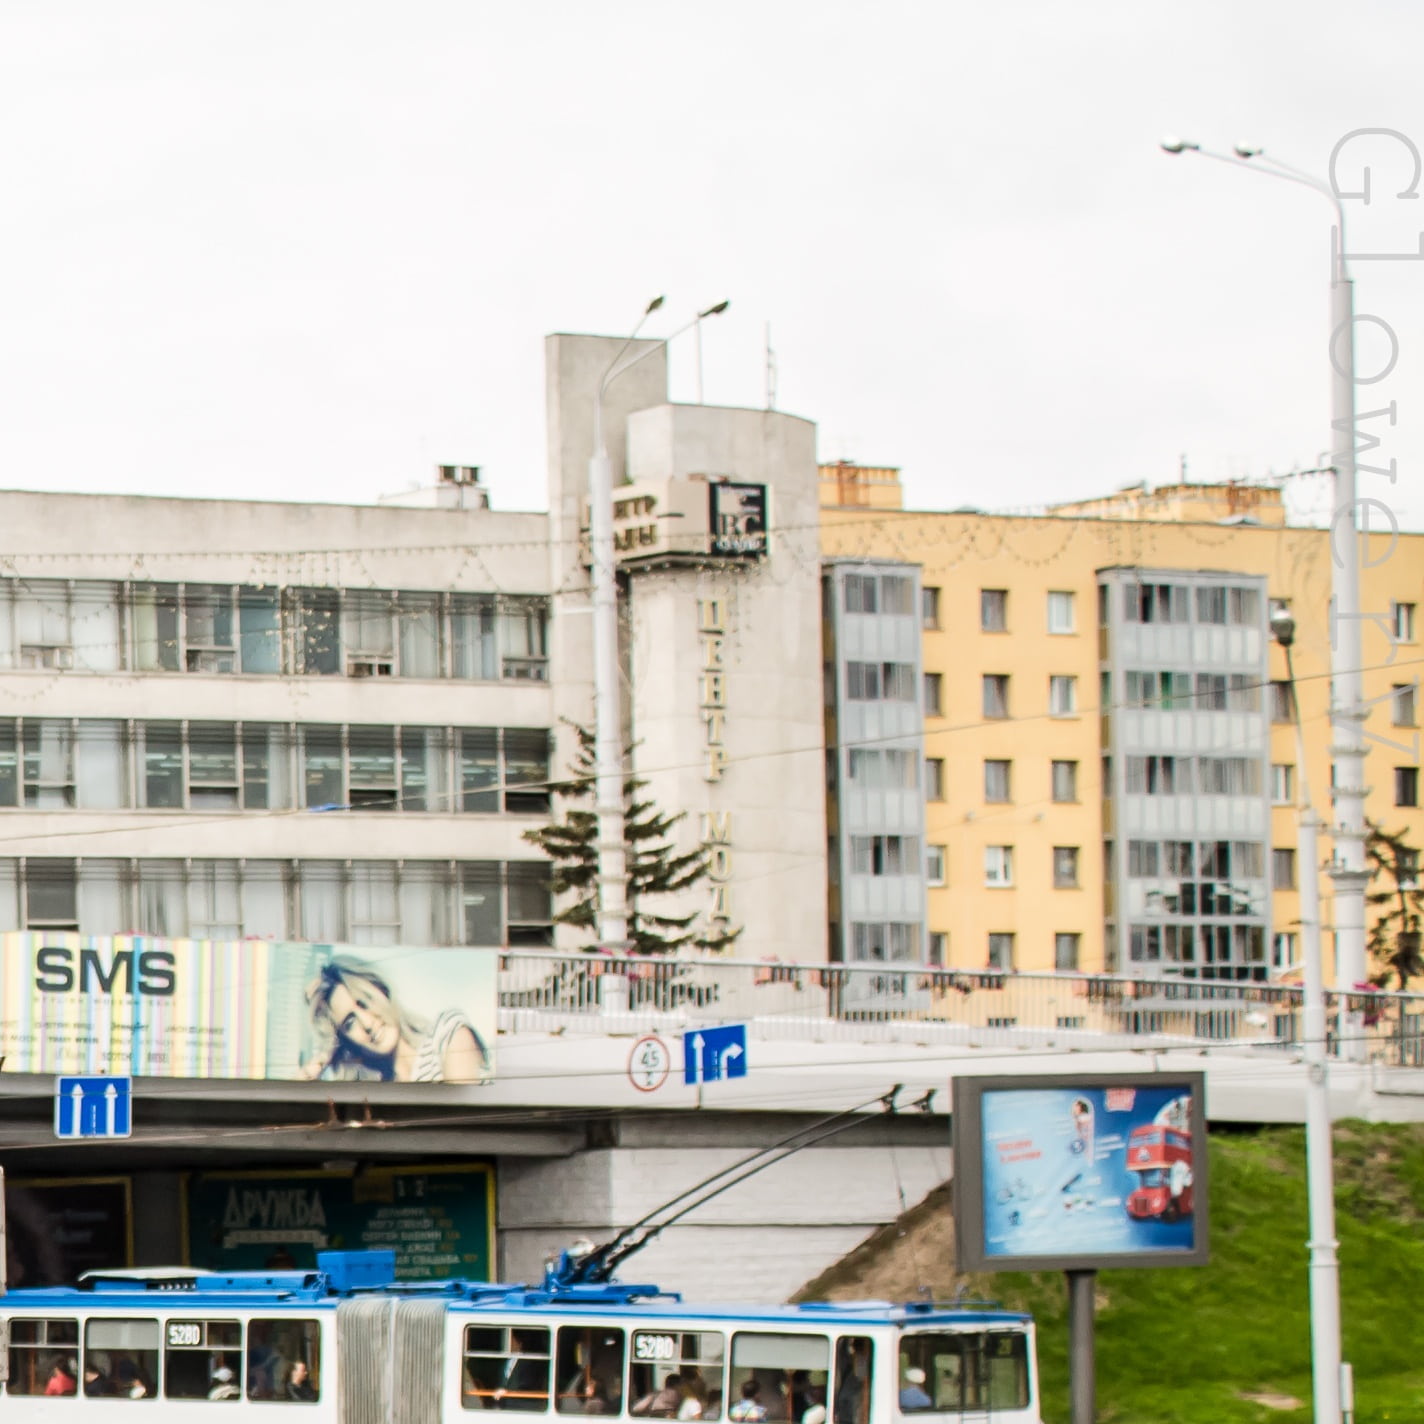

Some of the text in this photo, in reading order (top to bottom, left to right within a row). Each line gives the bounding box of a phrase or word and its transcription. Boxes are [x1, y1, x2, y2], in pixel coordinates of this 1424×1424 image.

[699, 600, 729, 783] ЦЕНТР
[35, 946, 176, 998] SMS
[223, 1185, 327, 1228] ДРУЖБА
[169, 1322, 200, 1346] 5280
